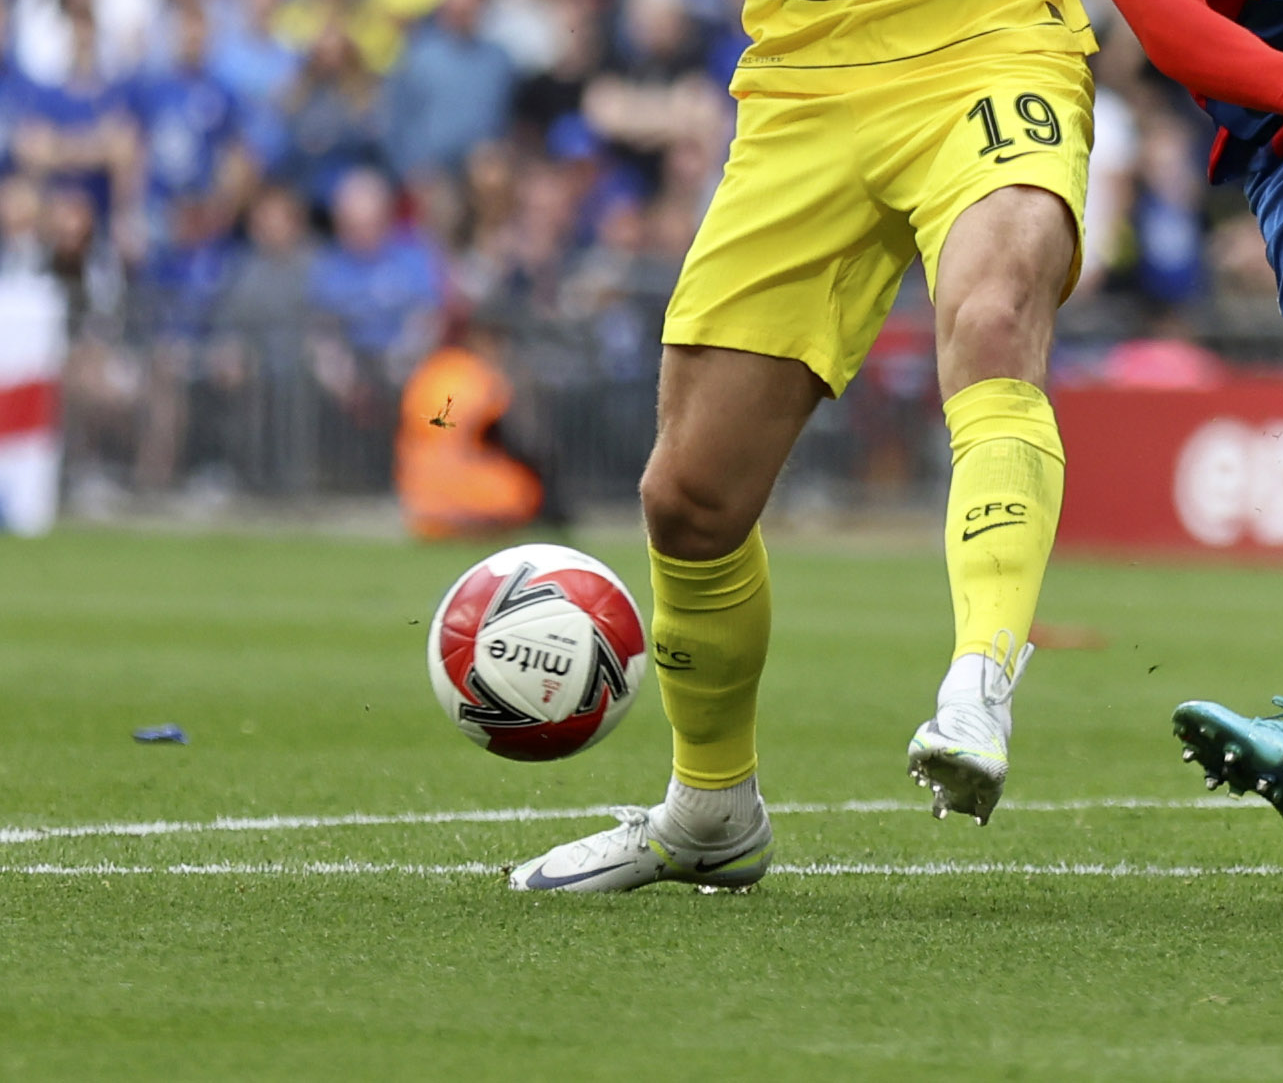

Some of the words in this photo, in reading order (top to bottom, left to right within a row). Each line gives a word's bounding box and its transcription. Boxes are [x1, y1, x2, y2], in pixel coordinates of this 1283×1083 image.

[966, 92, 1063, 159] 19
[965, 502, 1028, 521] CFC
[489, 639, 574, 677] mitre
[652, 641, 692, 664] FC
